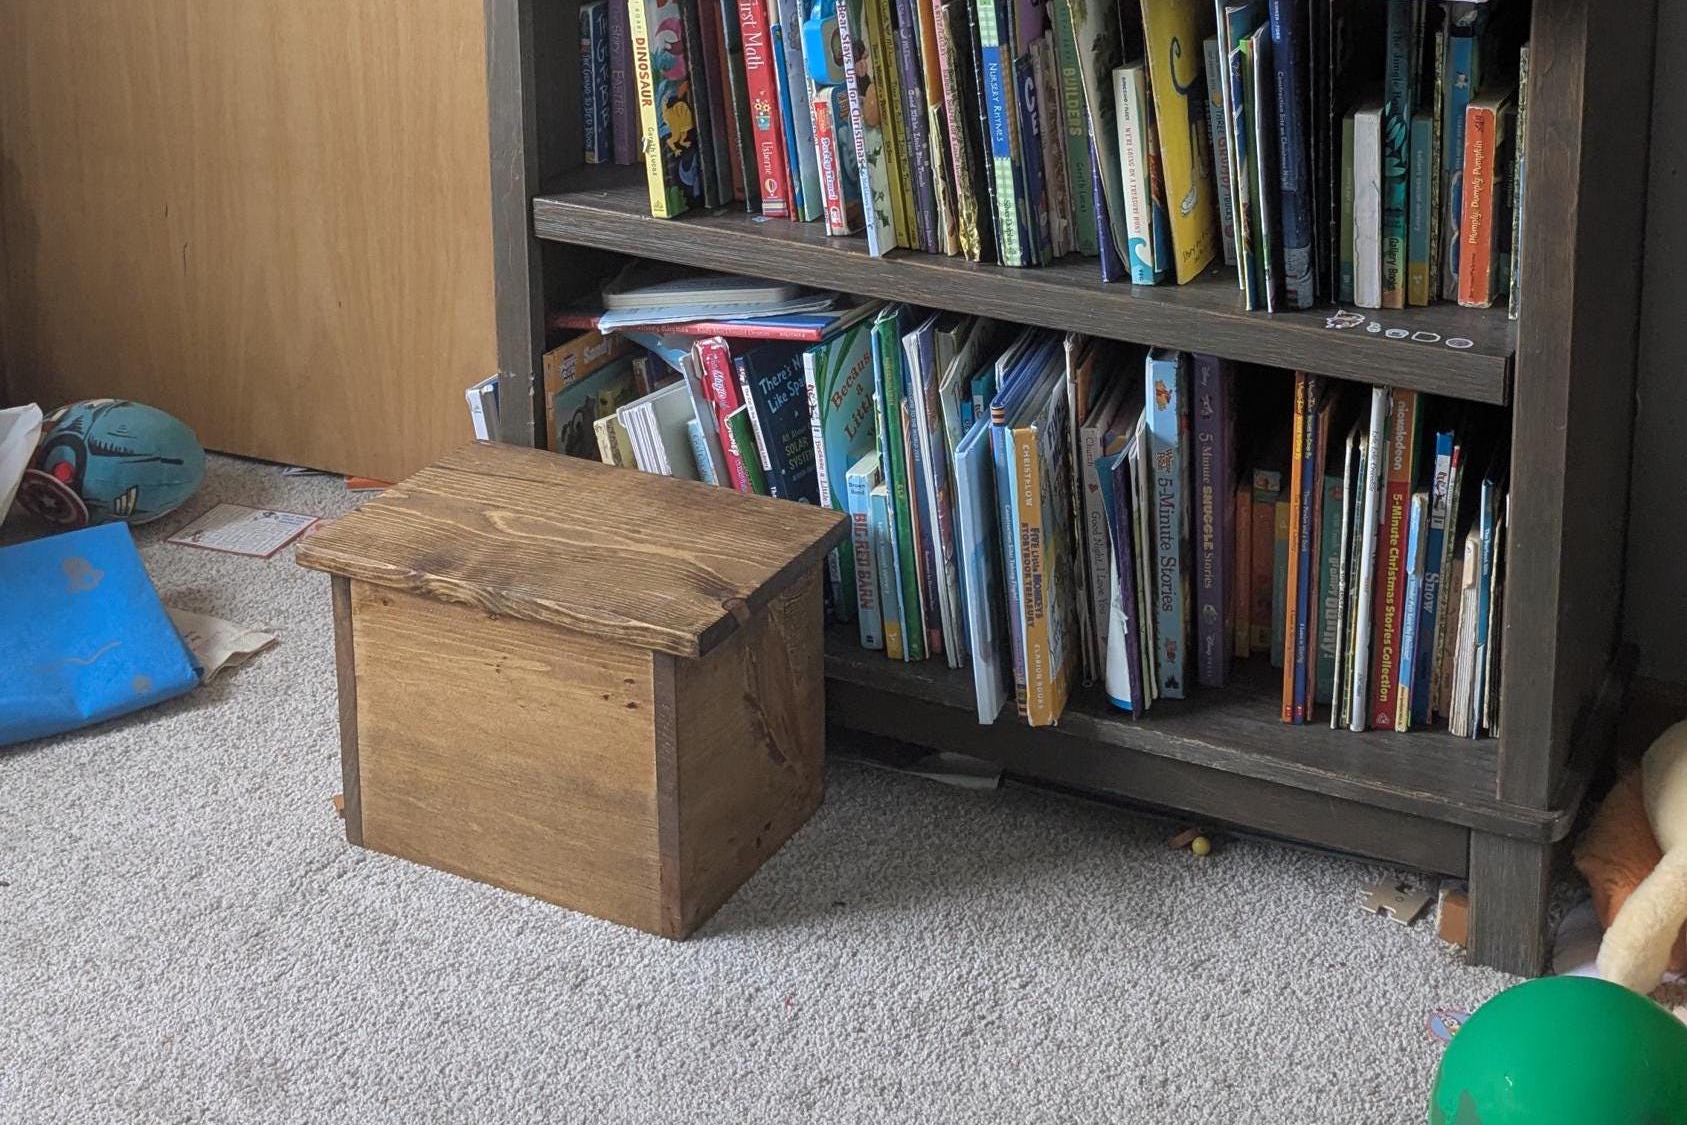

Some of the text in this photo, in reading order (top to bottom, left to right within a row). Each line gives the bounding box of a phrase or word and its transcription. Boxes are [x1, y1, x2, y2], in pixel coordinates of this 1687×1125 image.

[610, 26, 622, 54] Story
[743, 32, 764, 70] Math
[1391, 29, 1401, 50] The
[635, 37, 652, 107] DINOSAUR
[837, 5, 866, 164] Bear Stays Up for Christmas
[1389, 53, 1402, 87] Jungle
[612, 70, 625, 115] EASTER
[908, 90, 918, 108] Good
[989, 62, 1004, 142] NURSERY RHYMES
[1063, 67, 1083, 136] BUILDERS
[1277, 71, 1286, 112] Construction
[585, 128, 594, 149] BOOK
[647, 127, 661, 177] Gareth Lucas
[911, 133, 921, 151] Little
[1125, 127, 1133, 146] WE'RE
[760, 141, 774, 176] Usborne
[820, 137, 837, 201] Potty Time!
[914, 152, 923, 165] Blue
[1126, 148, 1134, 165] GOING
[1215, 109, 1225, 134] THREE
[1224, 192, 1233, 221] TRUCKS
[1472, 140, 1484, 175] Pumpkin
[916, 167, 925, 188] Truck
[1075, 162, 1087, 213] Gareth Lucas
[1129, 184, 1138, 213] TREASURE
[1003, 199, 1013, 246] Silver Dolphin
[1386, 237, 1400, 292] Gallery Books
[758, 364, 791, 395] There's
[831, 349, 871, 410] Becaus
[1200, 366, 1210, 386] Disney
[767, 392, 788, 414] Like
[1086, 437, 1095, 467] Church
[1393, 401, 1408, 470] nickelodeon
[820, 481, 830, 502] Little
[1022, 444, 1034, 508] CHRISTELOW
[1090, 510, 1101, 535] Good
[1198, 432, 1215, 589] 5-Minute SNUGGLE Stories
[853, 513, 874, 610] BIG RED BARN
[1158, 477, 1177, 612] 5-Minute Stories
[1021, 522, 1035, 628] STORYBOOK TREASURY
[1030, 527, 1044, 619] FIVE Little MONKEYS
[1096, 575, 1107, 595] Love
[1099, 598, 1109, 615] You
[1379, 493, 1403, 703] 5-Minute Christmas Stories Collection
[1423, 572, 1439, 614] Snow
[1205, 635, 1216, 656] Disney
[1034, 644, 1046, 710] CLARION BOOKS
